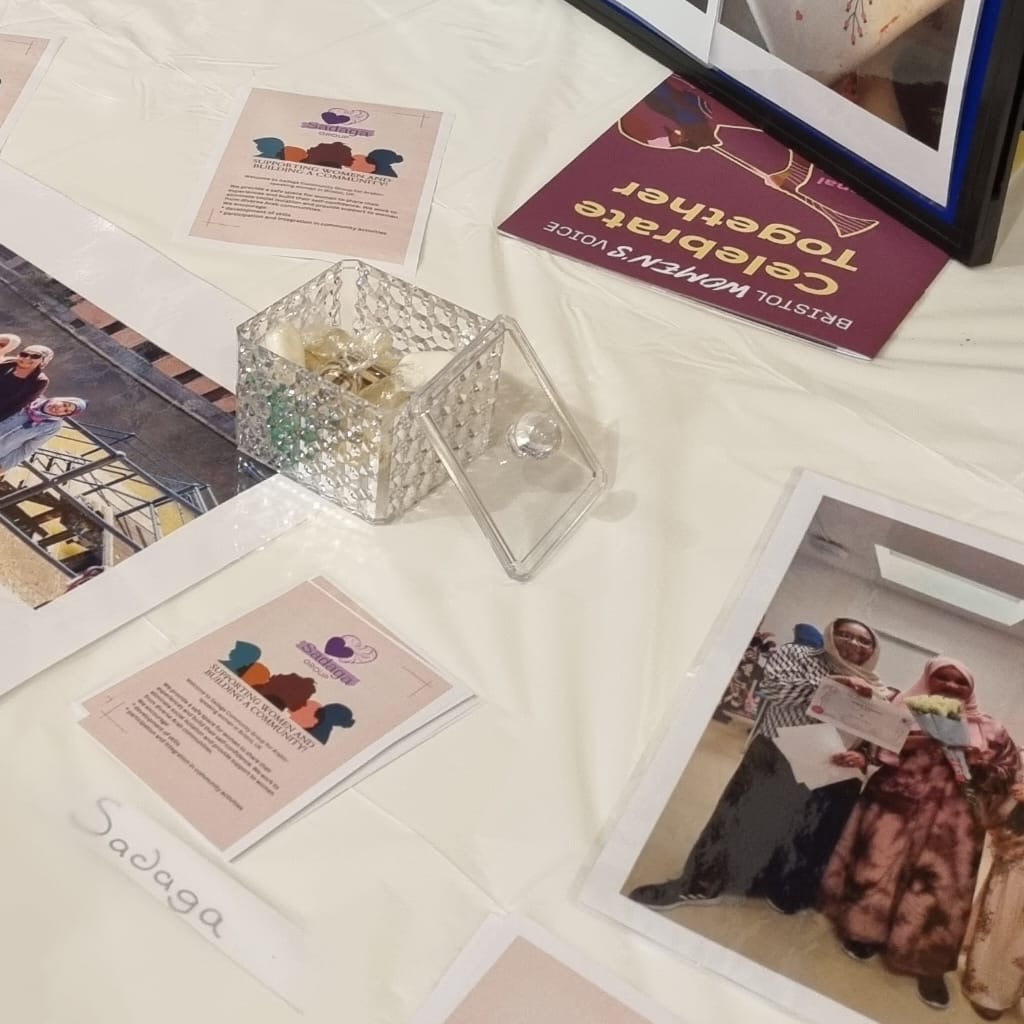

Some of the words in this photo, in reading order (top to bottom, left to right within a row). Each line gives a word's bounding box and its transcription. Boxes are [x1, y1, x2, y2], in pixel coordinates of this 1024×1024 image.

[305, 122, 370, 138] Sadaga
[252, 158, 319, 171] SUPPORTING
[321, 168, 364, 178] WOMEN
[252, 163, 304, 174] BUILDING
[315, 172, 388, 186] COMMUNITY!
[544, 220, 608, 253] VOICE
[573, 199, 840, 297] Celebrate
[612, 180, 859, 272] Together
[607, 245, 749, 298] WOMEN'S
[756, 289, 854, 331] BRISTOL
[297, 642, 358, 687] Sadaga
[203, 668, 246, 702] BUILDING
[241, 699, 253, 708] A
[248, 705, 308, 754] COMMUNITY!
[209, 662, 264, 705] SUPPORTING
[259, 703, 297, 733] WOMEN
[292, 730, 317, 749] AND
[68, 796, 225, 940] Sadaga
